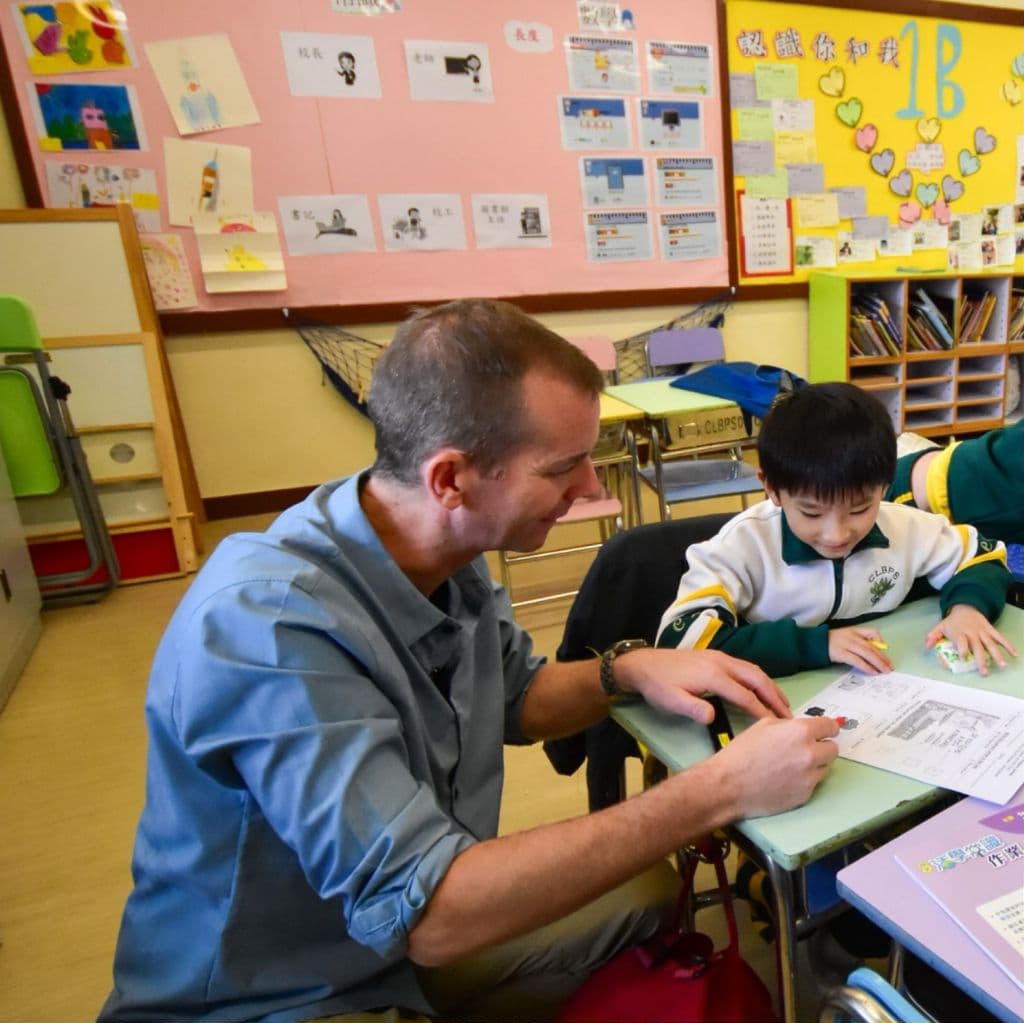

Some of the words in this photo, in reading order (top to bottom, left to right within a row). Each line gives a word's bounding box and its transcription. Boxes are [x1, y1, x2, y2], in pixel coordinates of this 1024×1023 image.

[736, 28, 901, 68] 認識你和我
[896, 19, 966, 120] 1B
[868, 565, 901, 584] CLBPS
